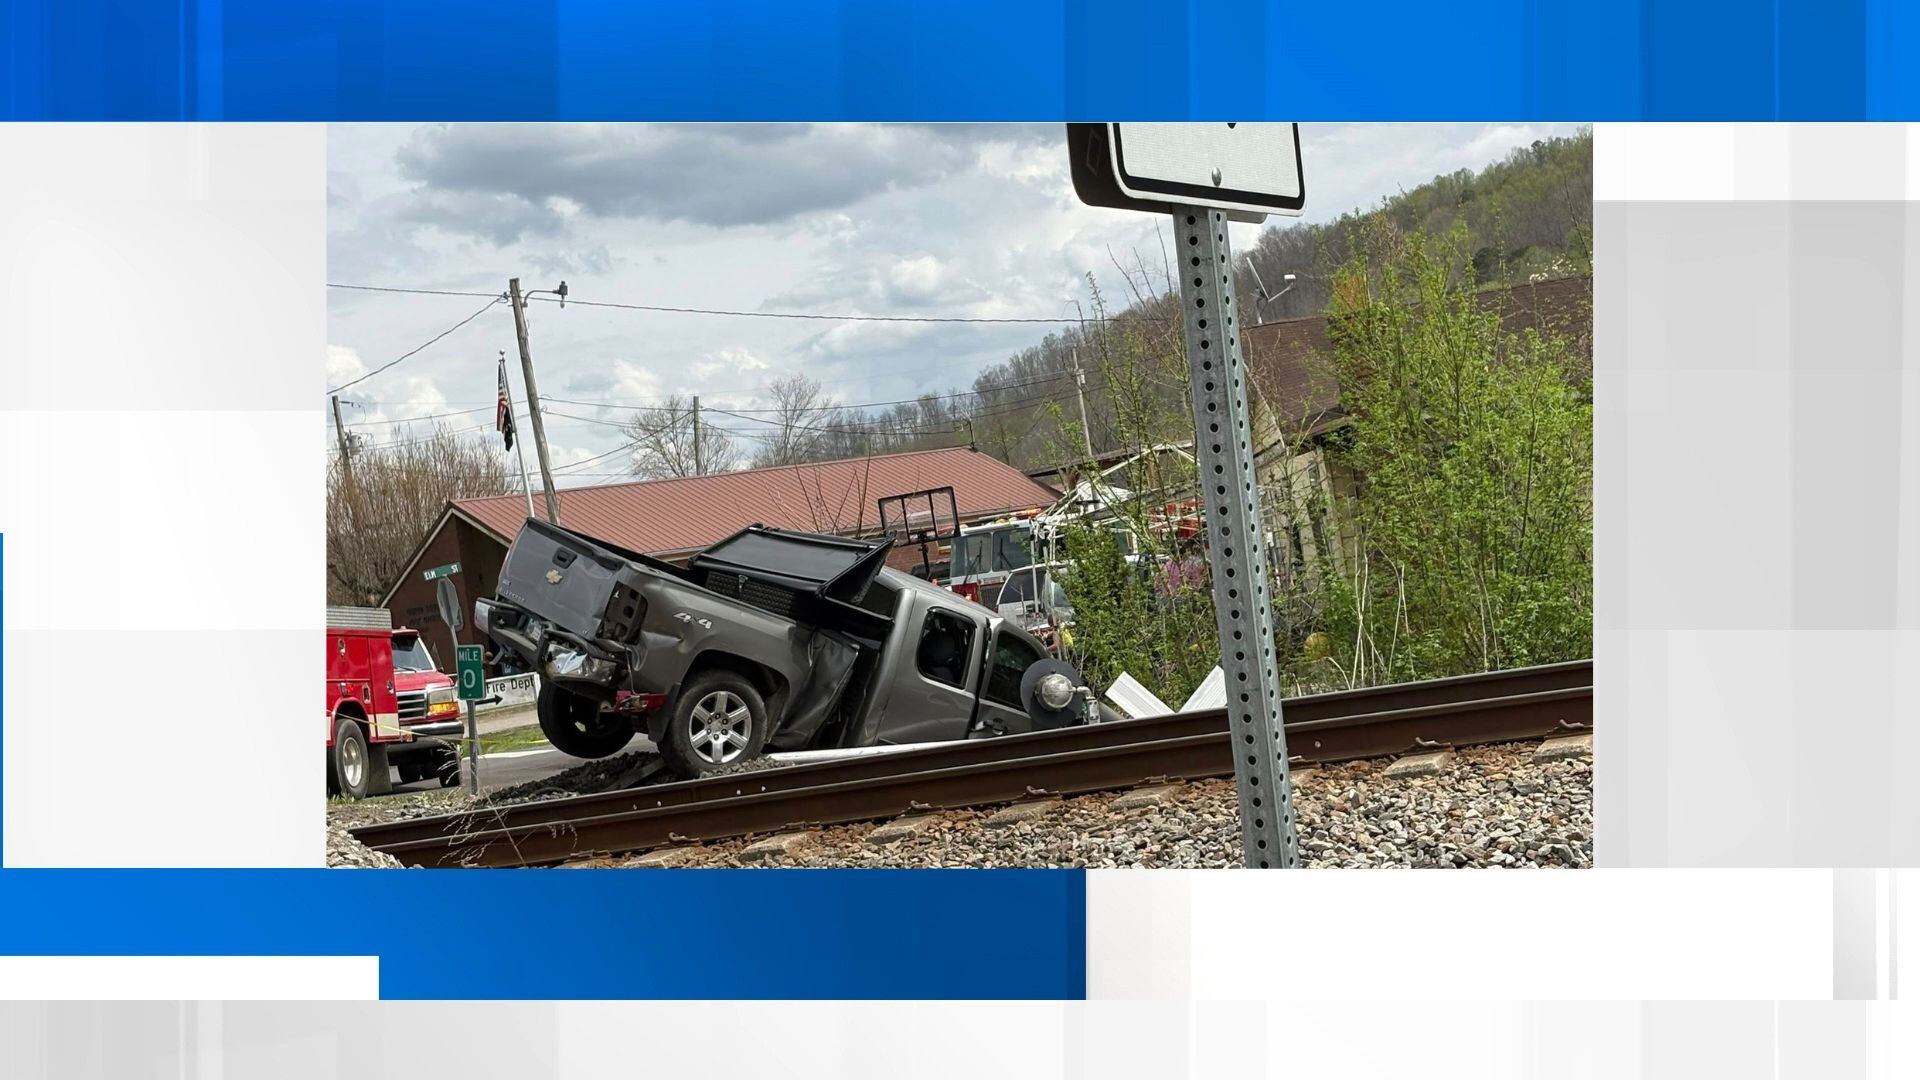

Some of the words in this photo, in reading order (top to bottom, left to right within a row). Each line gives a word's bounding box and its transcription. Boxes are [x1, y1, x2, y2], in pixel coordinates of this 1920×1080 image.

[424, 570, 437, 580] ELM
[451, 564, 459, 573] ST
[458, 650, 478, 661] MILE
[464, 669, 475, 688] 0
[486, 682, 506, 694] Fire
[511, 676, 535, 690] Dept
